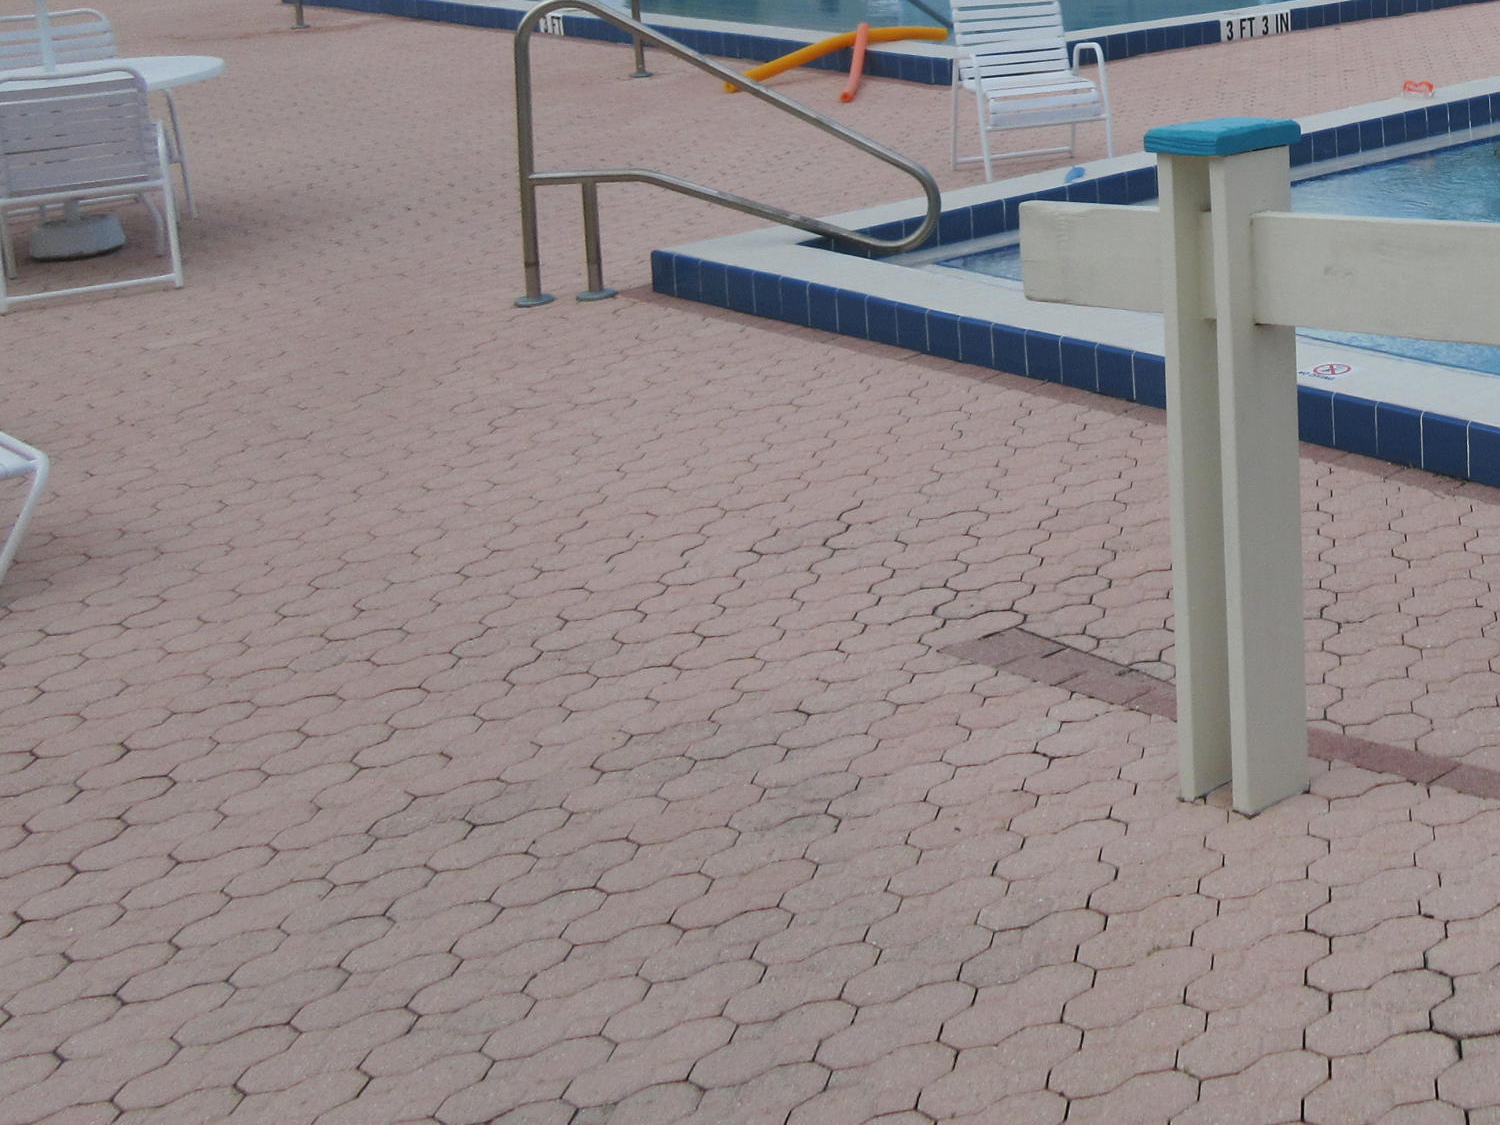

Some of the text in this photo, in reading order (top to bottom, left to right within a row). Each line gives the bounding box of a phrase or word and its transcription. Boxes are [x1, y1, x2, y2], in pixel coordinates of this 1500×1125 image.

[1226, 12, 1289, 40] 3 FT 3 IN
